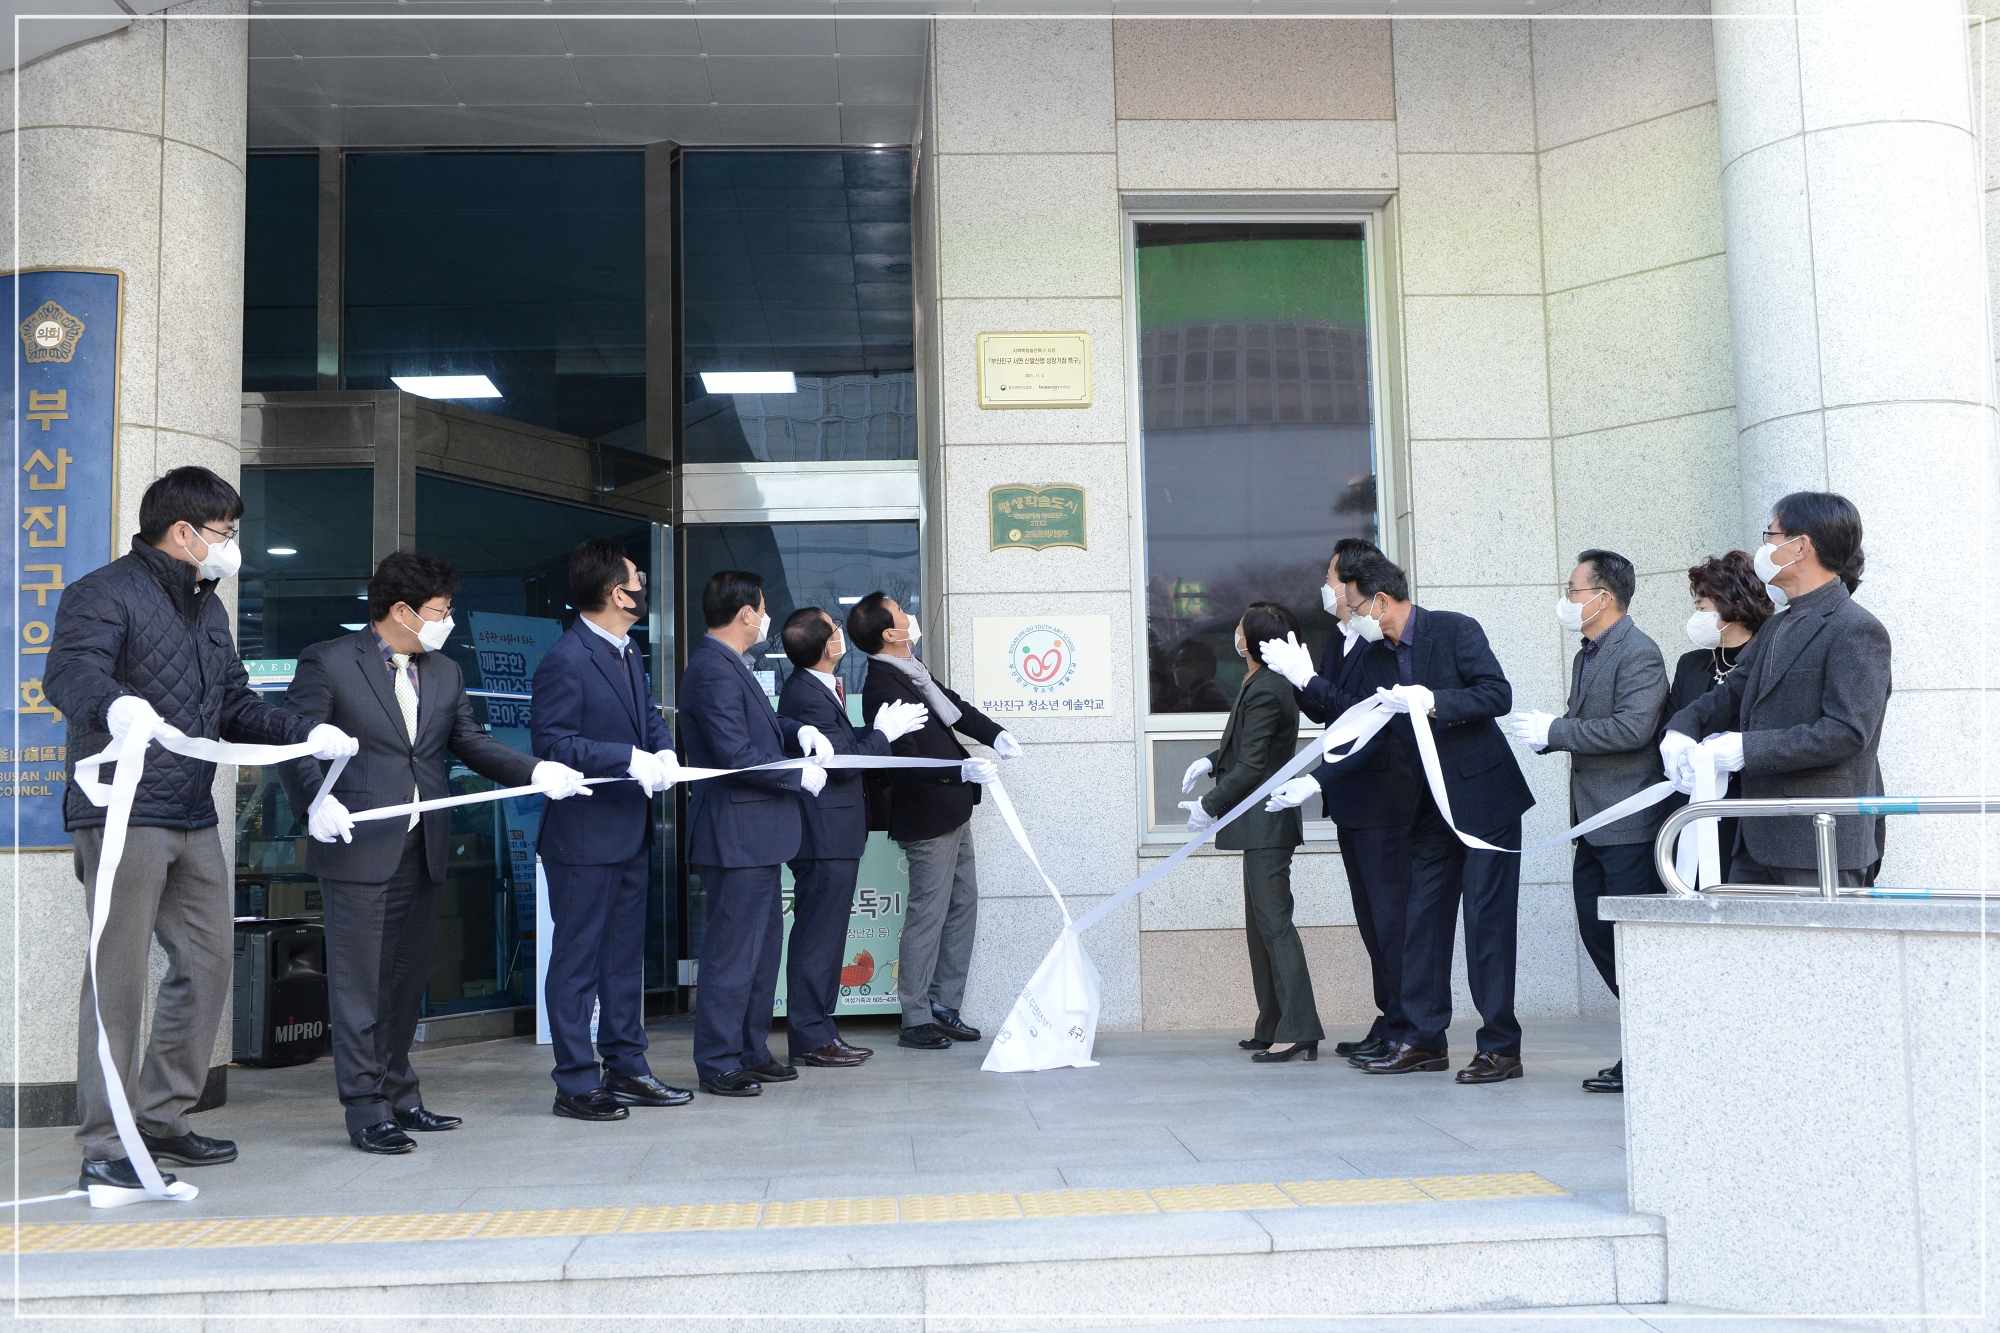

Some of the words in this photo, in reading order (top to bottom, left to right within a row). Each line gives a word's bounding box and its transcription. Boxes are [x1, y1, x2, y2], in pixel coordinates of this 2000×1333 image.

[37, 326, 60, 341] 의회
[997, 495, 1079, 515] 평생학습도시
[479, 630, 498, 643] 소중한
[1052, 627, 1063, 635] ART
[1062, 633, 1076, 653] SCHOOL
[258, 663, 291, 671] AED
[480, 651, 524, 673] 깨끗한
[1008, 663, 1028, 688] 부산진구
[982, 699, 1025, 711] 부산진구
[1027, 699, 1059, 711] 청소년
[1062, 698, 1104, 711] 예술학교
[490, 704, 516, 725] 모아
[44, 771, 66, 782] JIN
